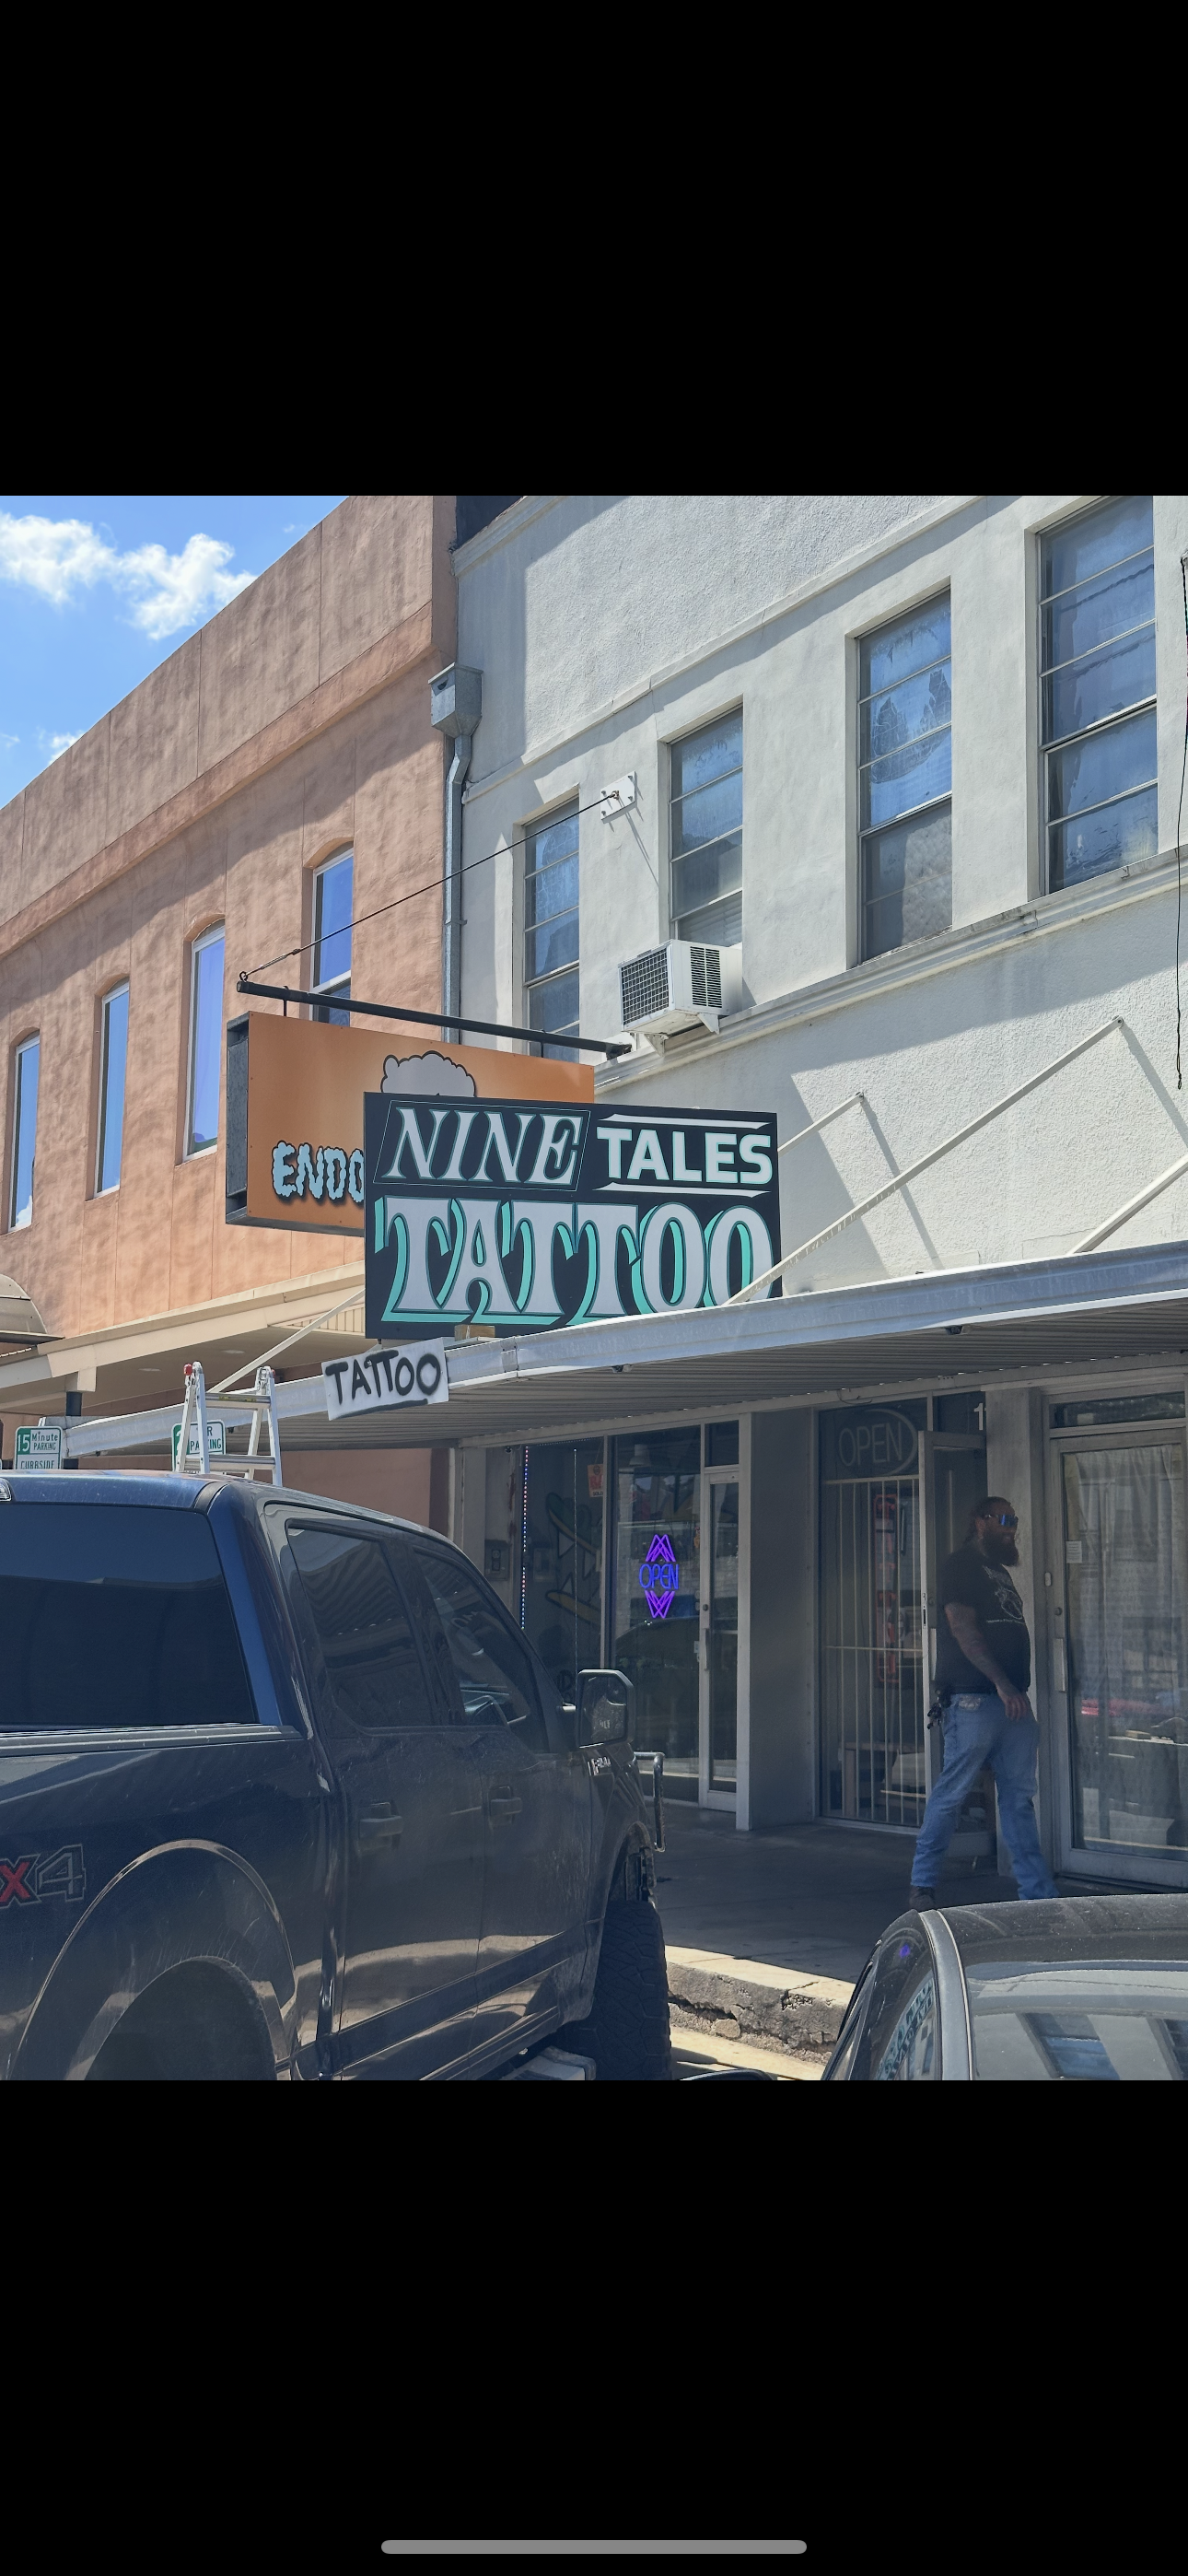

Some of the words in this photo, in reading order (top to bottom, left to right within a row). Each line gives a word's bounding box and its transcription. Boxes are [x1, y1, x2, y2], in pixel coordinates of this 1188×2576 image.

[381, 1107, 584, 1185] NINE
[596, 1127, 774, 1185] TALES
[272, 1141, 365, 1203] ENDO
[375, 1196, 774, 1325] TATTOO
[325, 1350, 442, 1405] TATTOO
[973, 1402, 987, 1431] 1
[17, 1434, 30, 1452] 15
[31, 1431, 58, 1442] Minute
[33, 1442, 57, 1451] PARKING
[190, 1438, 222, 1451] PAING
[838, 1421, 903, 1467] OPEN
[638, 1563, 680, 1590] OPEN
